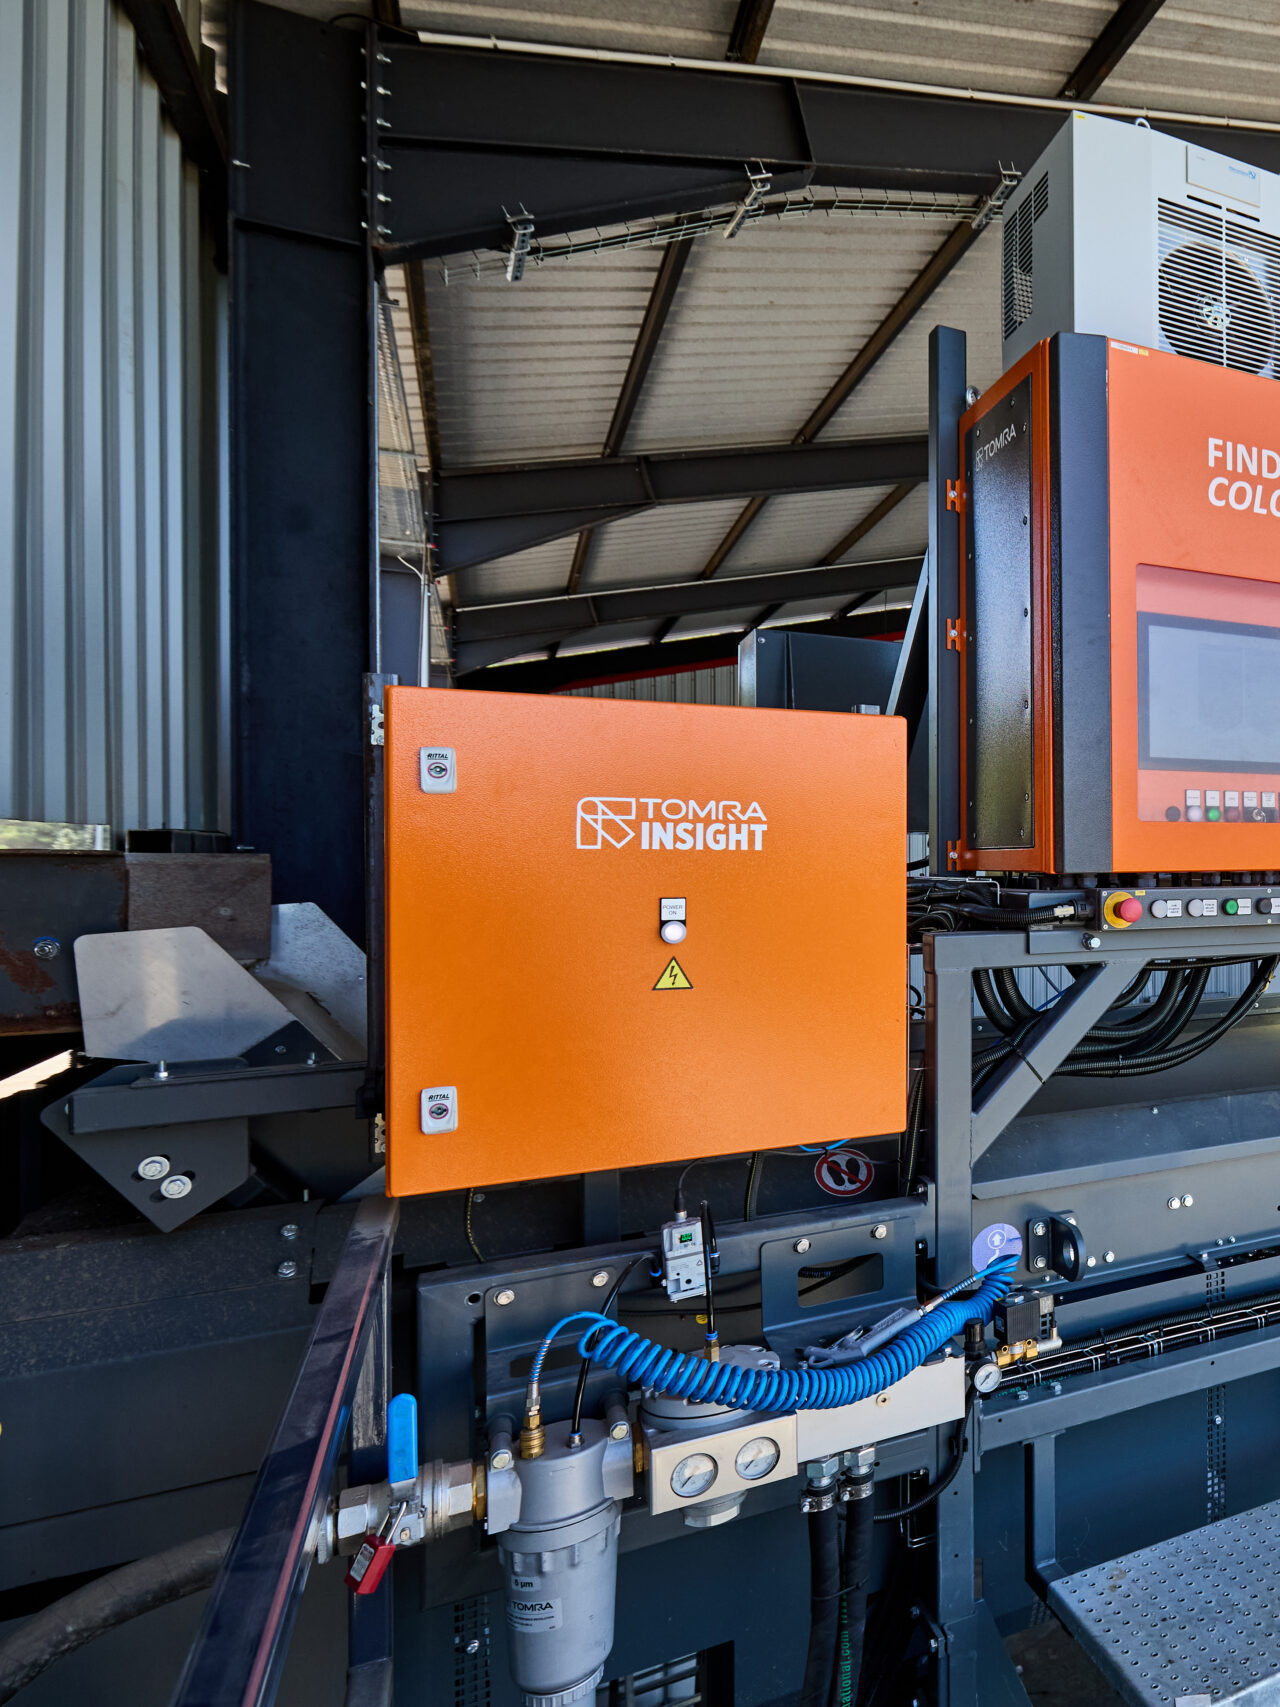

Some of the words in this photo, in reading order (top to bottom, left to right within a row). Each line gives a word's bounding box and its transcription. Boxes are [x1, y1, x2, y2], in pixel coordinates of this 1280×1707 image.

[984, 424, 1017, 461] TOMRA
[639, 798, 768, 821] TOMRA
[641, 821, 768, 851] INSIGHT
[428, 1093, 450, 1101] RITTAL
[511, 1600, 554, 1612] TOMRA
